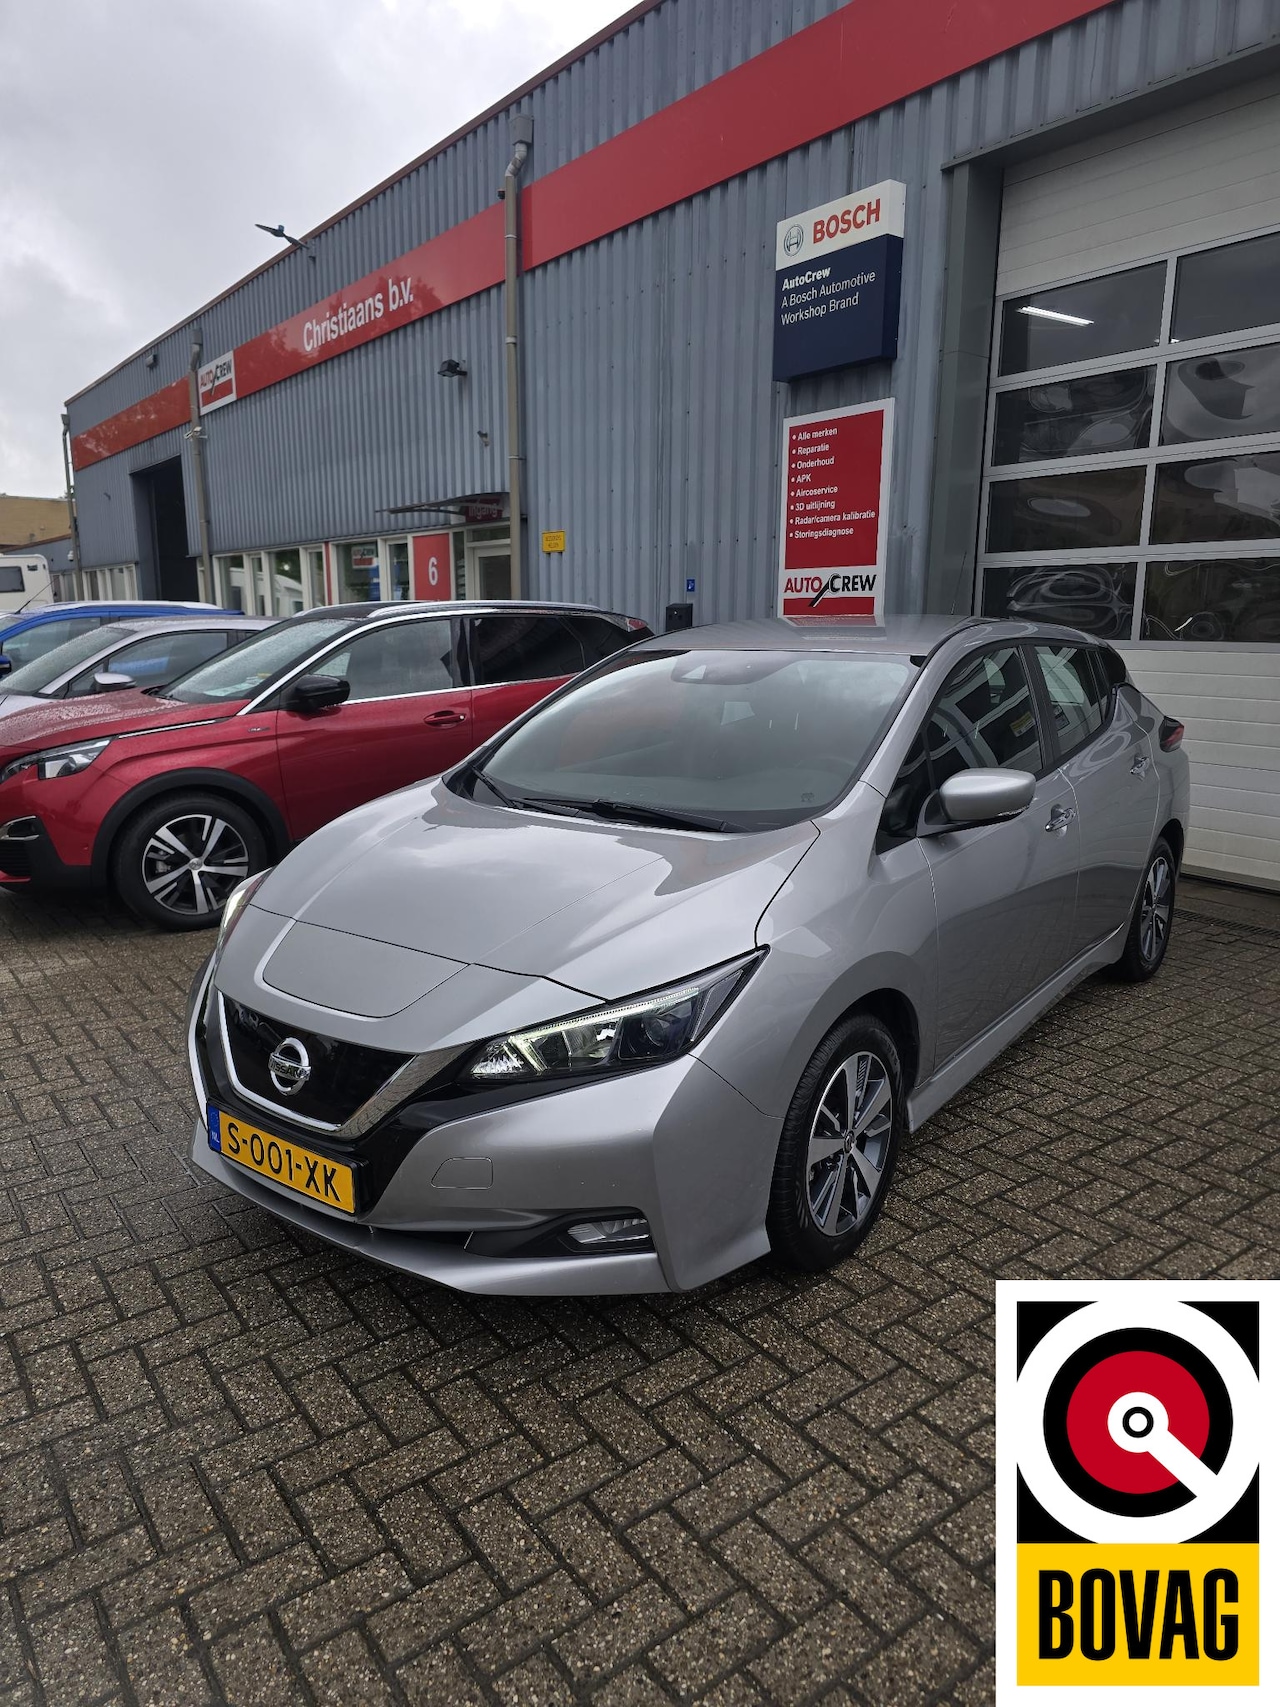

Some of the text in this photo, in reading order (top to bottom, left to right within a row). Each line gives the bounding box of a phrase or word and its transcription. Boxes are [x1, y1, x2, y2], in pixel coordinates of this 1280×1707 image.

[813, 198, 880, 244] BOSCH
[782, 267, 831, 291] AutoCrew
[781, 271, 876, 309] A Bosch Automotive
[303, 277, 414, 352] Christiaans b.v.
[780, 292, 859, 325] Workshop Brand
[797, 427, 838, 441] Alle merken
[797, 443, 830, 455] Reparatie
[797, 456, 835, 470] Onderhoud
[796, 473, 812, 483] APK
[795, 485, 838, 497] Aircoservice
[795, 500, 836, 511] 3D uitlijning
[794, 510, 876, 525] Radar/camera kalibratie
[794, 527, 854, 539] Storingsdiagnose
[428, 556, 438, 586] 6
[784, 574, 877, 593] AUTO CREW
[228, 1122, 341, 1202] S-001-XK
